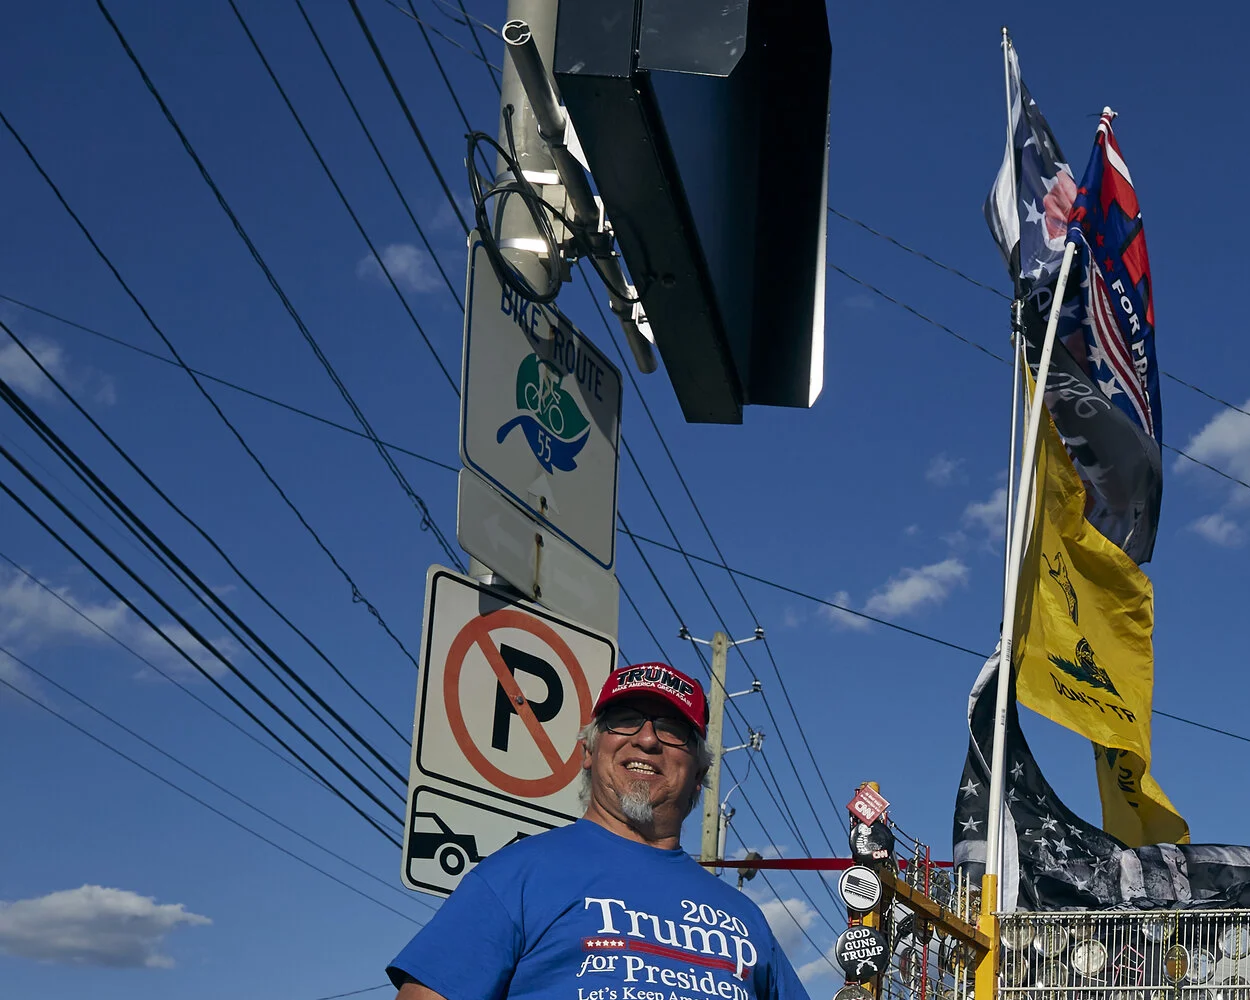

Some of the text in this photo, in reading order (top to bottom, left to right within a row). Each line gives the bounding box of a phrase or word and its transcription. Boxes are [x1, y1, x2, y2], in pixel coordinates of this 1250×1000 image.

[1112, 278, 1140, 335] FOR
[500, 284, 605, 403] BIKE ROUTE
[538, 429, 552, 463] 55
[617, 667, 694, 696] TRUMP
[612, 684, 627, 693] MAKE
[657, 683, 677, 696] GREAT
[675, 691, 692, 708] AGAIN
[854, 800, 876, 820] CNN
[680, 899, 749, 937] 2020
[584, 897, 757, 981] Trump
[845, 937, 876, 950] GUNS
[846, 929, 870, 940] GOD
[576, 954, 618, 978] for
[841, 946, 883, 961] TRUMP
